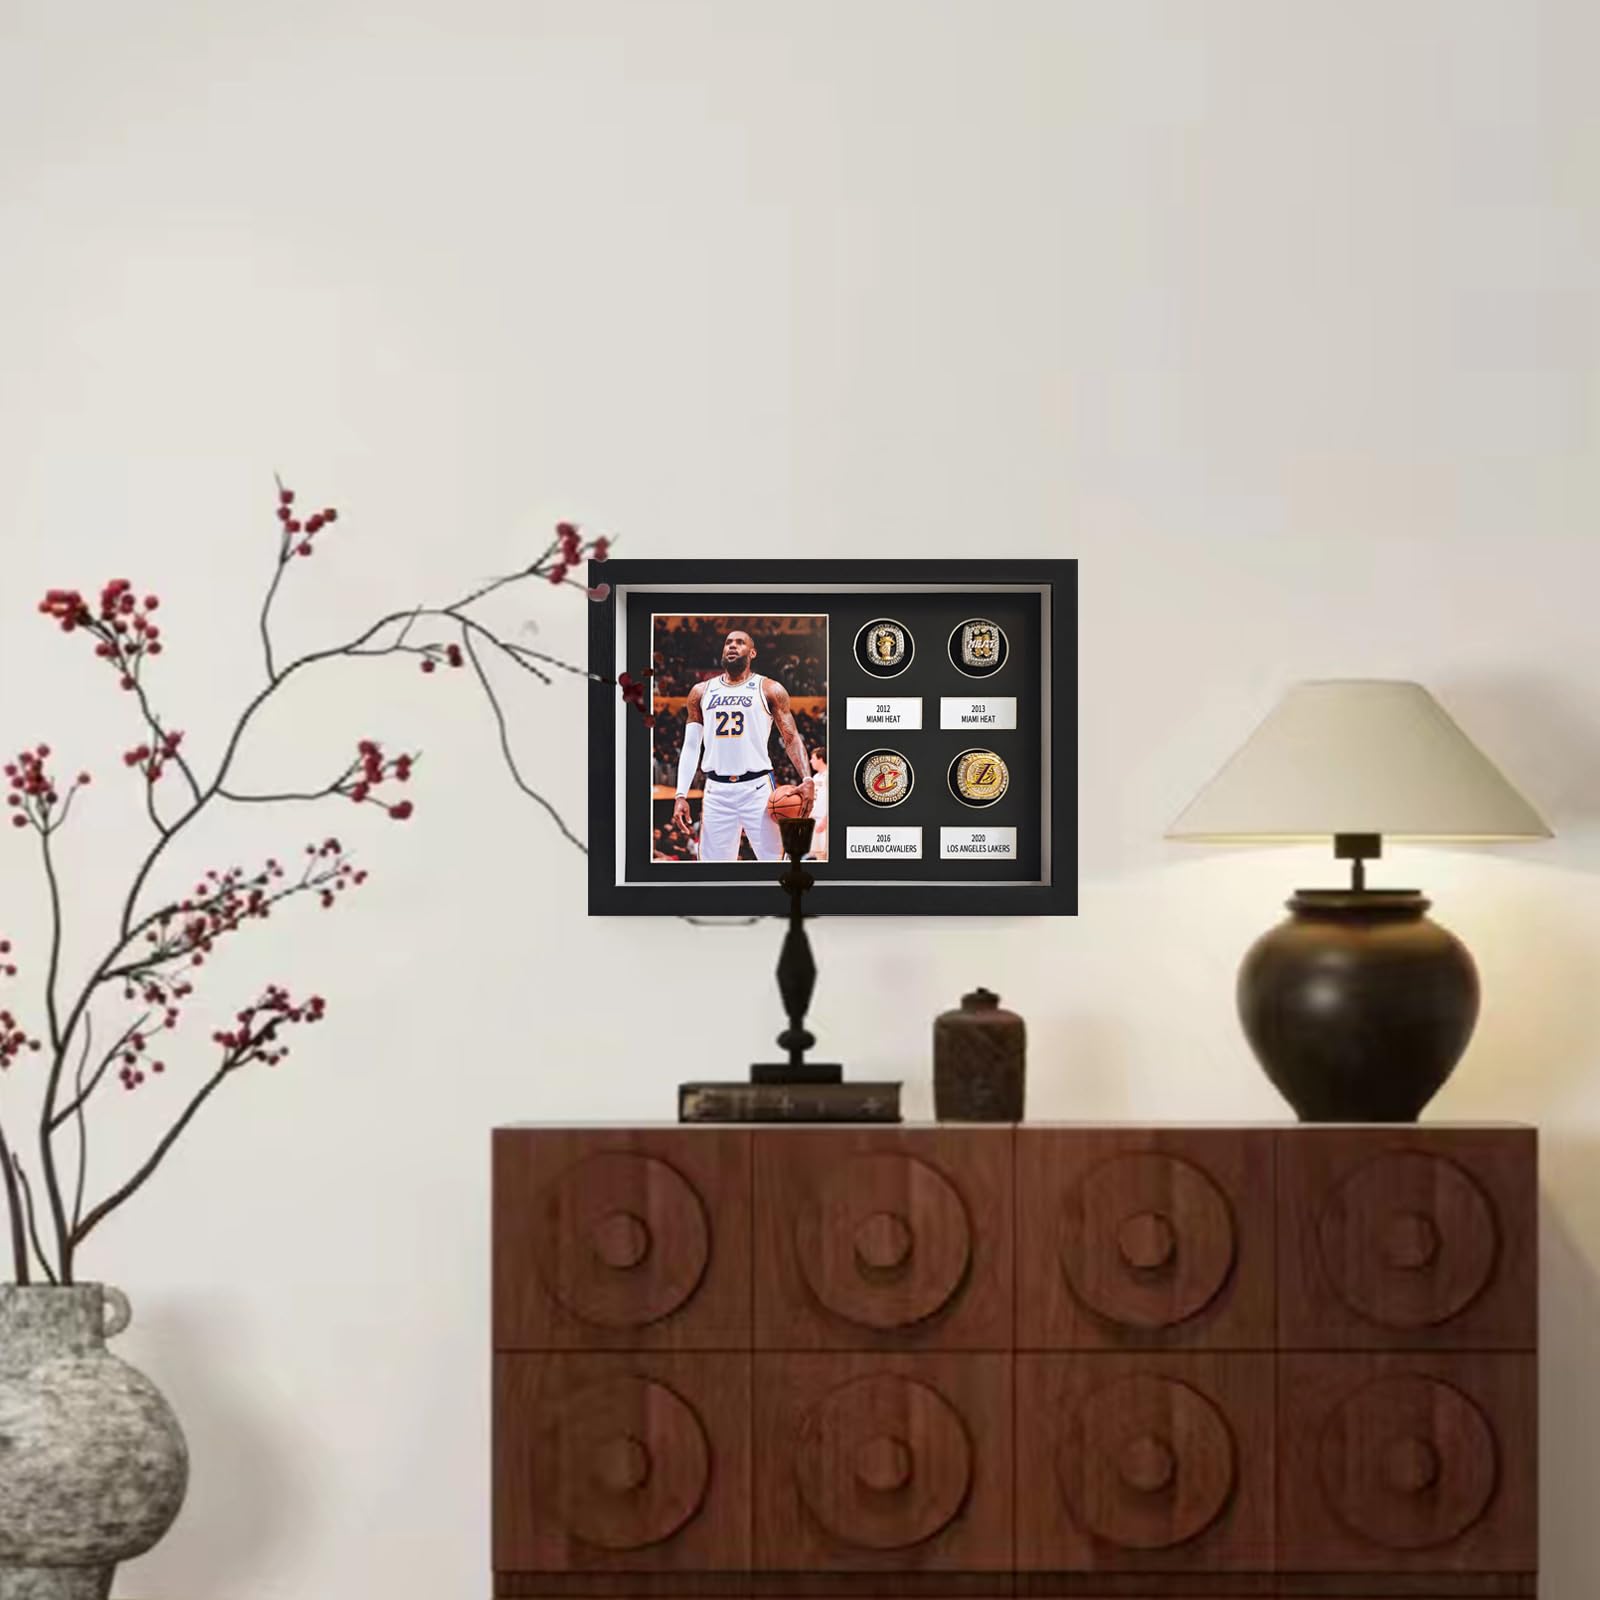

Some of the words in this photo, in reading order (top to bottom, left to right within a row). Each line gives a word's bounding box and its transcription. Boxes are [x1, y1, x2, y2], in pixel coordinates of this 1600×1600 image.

[706, 694, 753, 710] LAKERS
[877, 704, 891, 712] 2012
[971, 704, 986, 712] 2013
[866, 714, 884, 722] MIAMI
[885, 714, 901, 722] HEAT
[961, 714, 979, 722] MIAMI
[980, 714, 996, 722] HEAT
[715, 711, 744, 735] 23
[877, 834, 891, 842] 2016
[971, 834, 986, 842] 2020
[850, 844, 884, 852] CLEVELAND
[885, 844, 917, 852] CAVALIERS
[947, 844, 959, 852] LOS
[960, 844, 987, 852] ANGELES
[988, 844, 1011, 852] LAKERS
